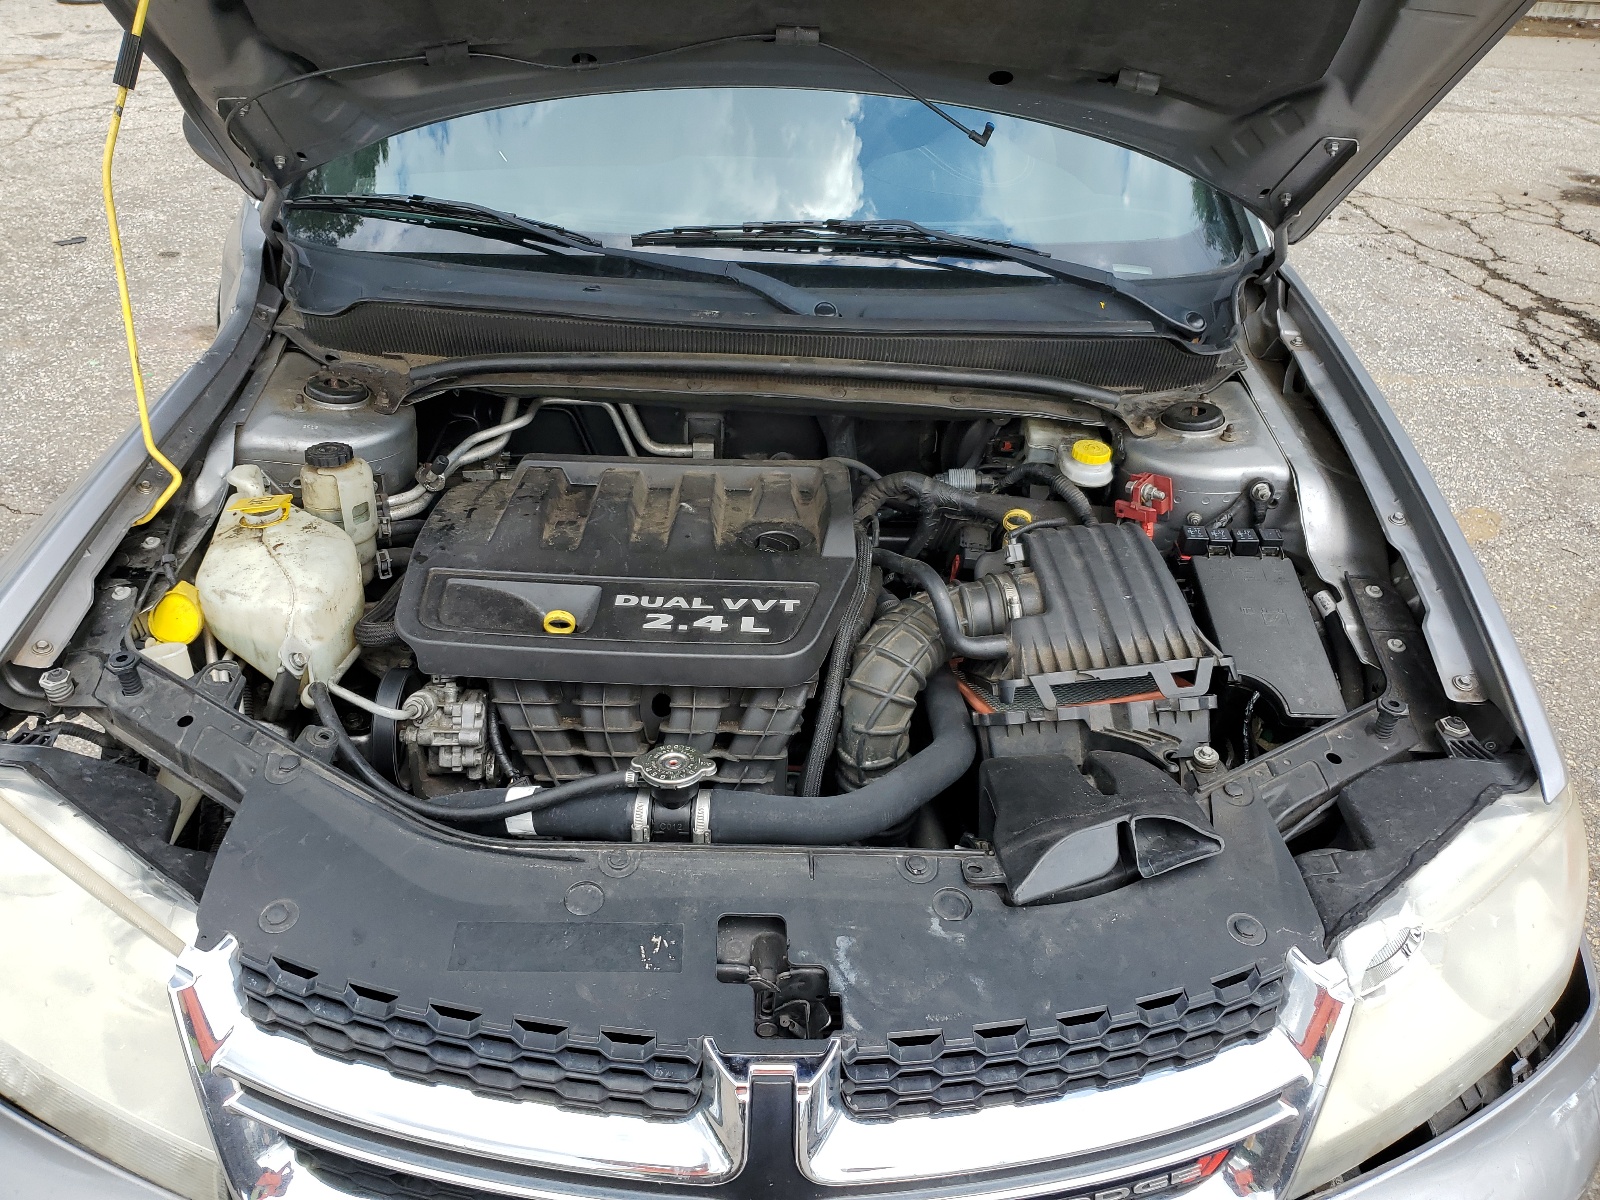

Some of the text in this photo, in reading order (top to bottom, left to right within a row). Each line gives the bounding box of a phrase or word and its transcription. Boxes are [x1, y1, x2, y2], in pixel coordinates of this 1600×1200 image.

[614, 594, 801, 613] DUAL VVT
[1068, 1163, 1203, 1200] DGE
